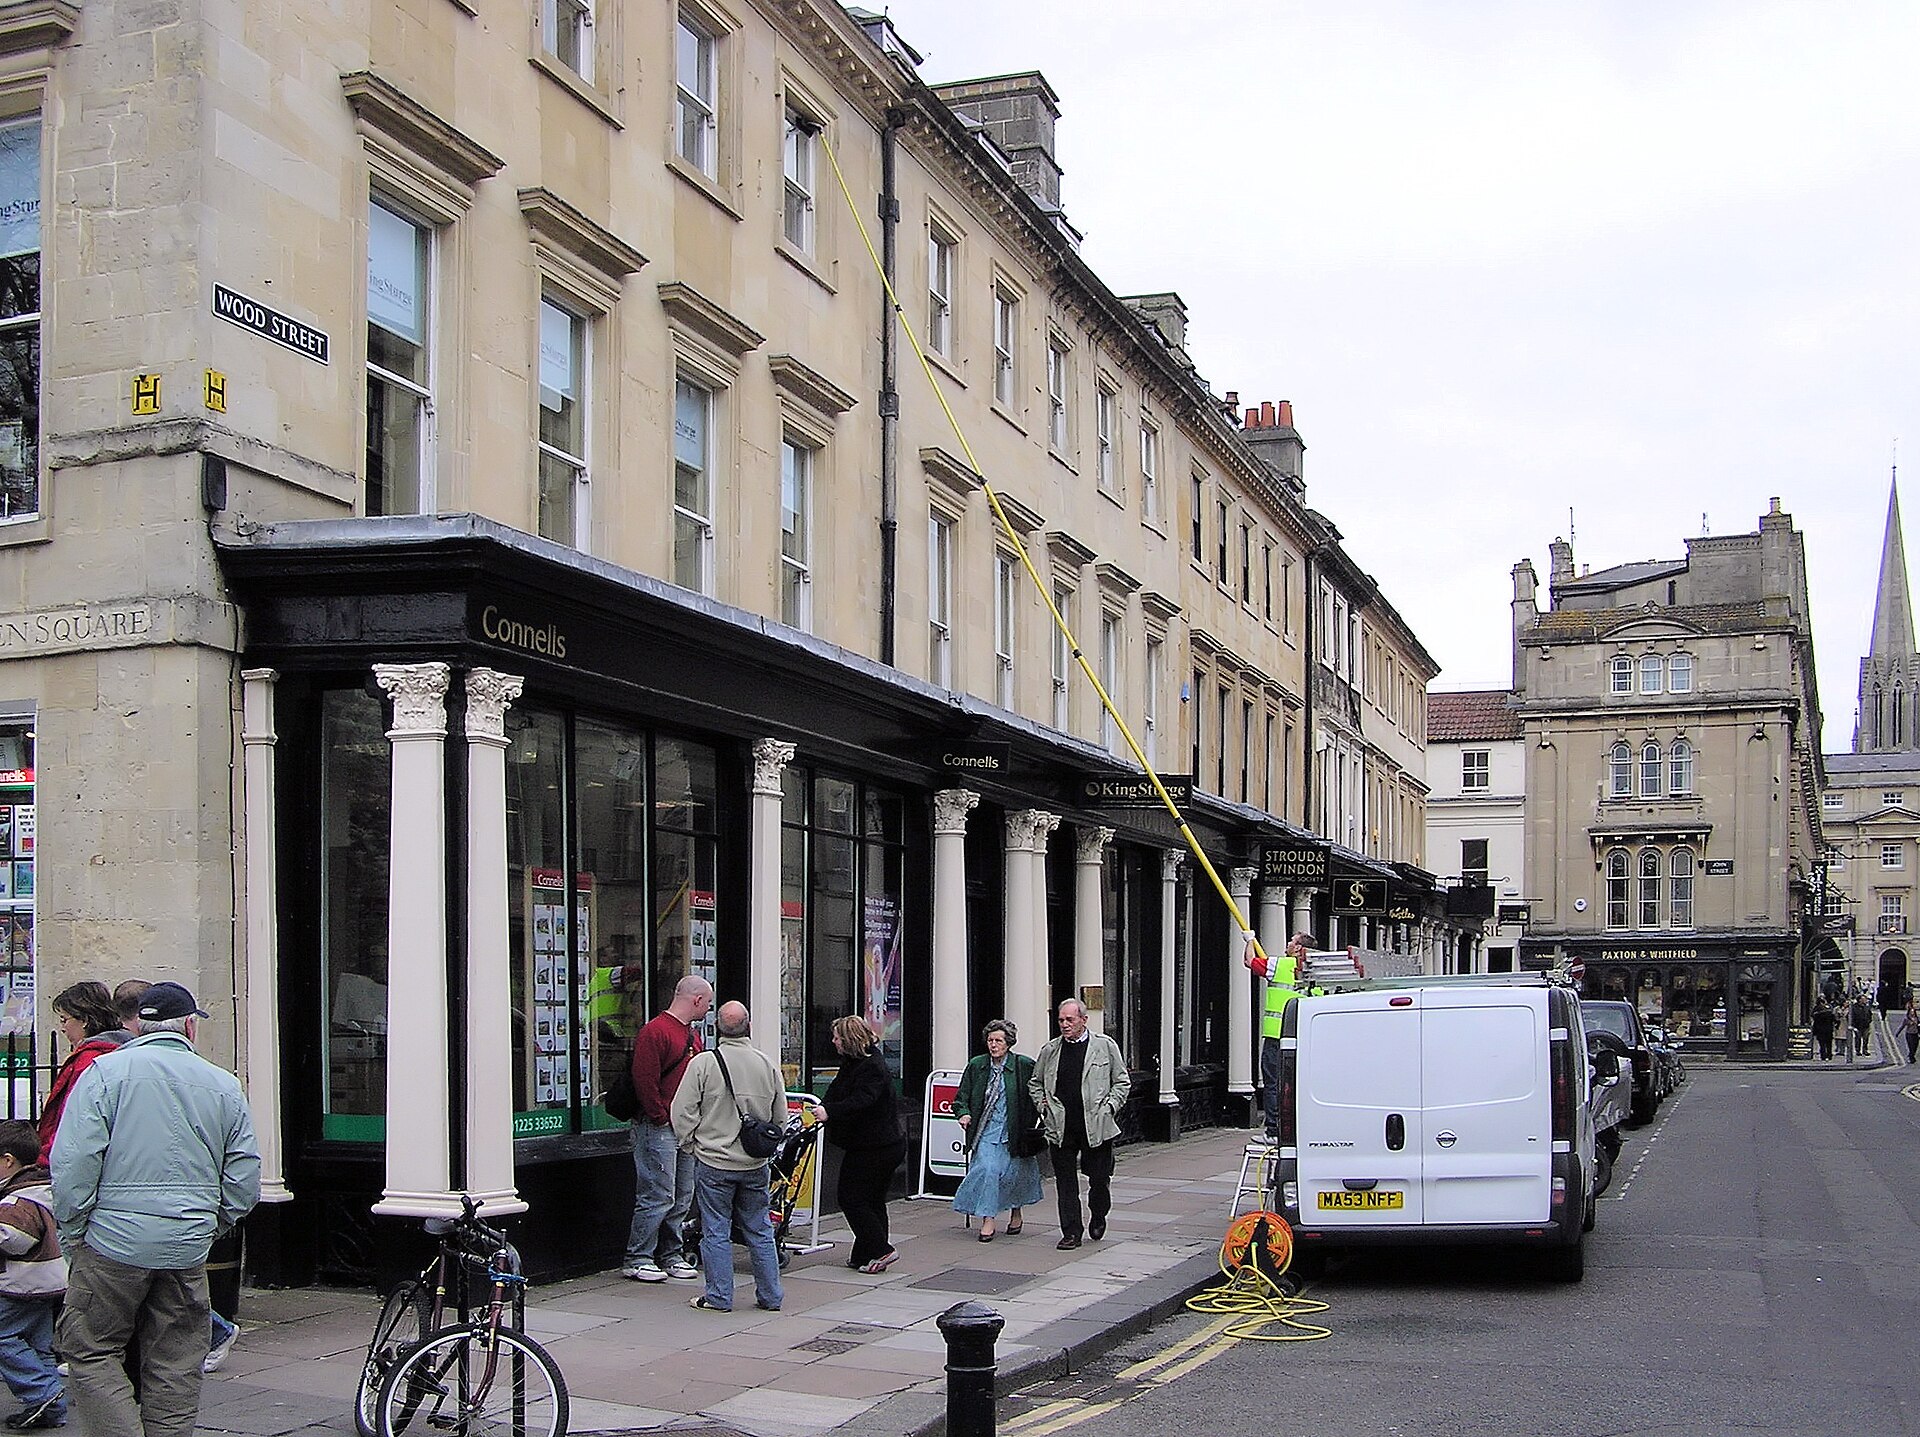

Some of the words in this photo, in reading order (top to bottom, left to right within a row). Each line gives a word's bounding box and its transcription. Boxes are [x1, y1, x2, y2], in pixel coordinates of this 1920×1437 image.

[218, 290, 266, 328] WOOD
[271, 316, 325, 355] STREET
[35, 610, 148, 645] SQUARE
[482, 605, 567, 659] Connells
[942, 753, 999, 769] Connells
[1265, 863, 1325, 875] SWINDON
[1602, 951, 1637, 959] PAXTON
[1649, 950, 1697, 959] WHITFIELD
[535, 1116, 563, 1130] 336522
[1323, 1192, 1363, 1207] MA53
[1367, 1192, 1397, 1206] NFF
